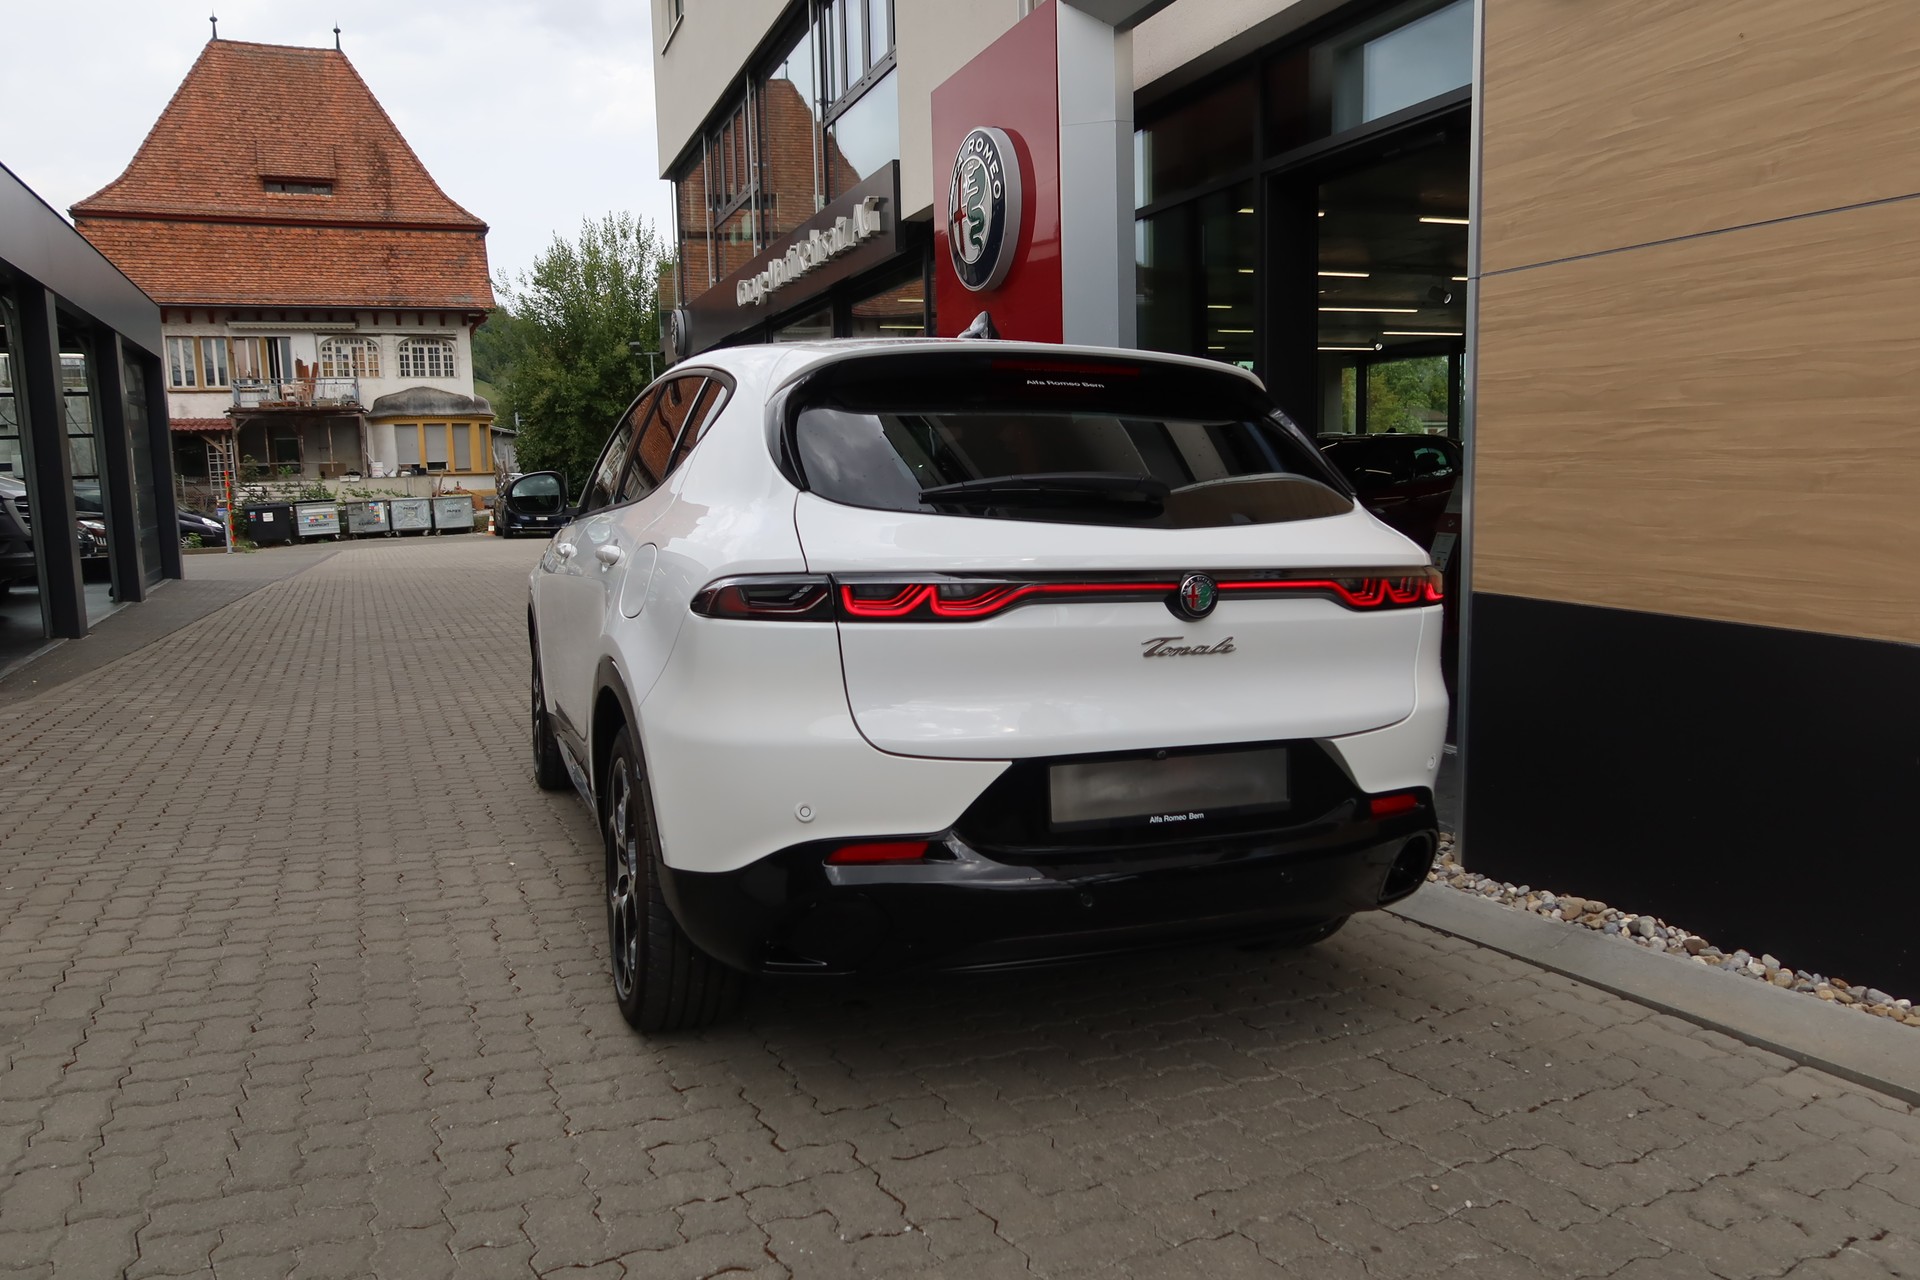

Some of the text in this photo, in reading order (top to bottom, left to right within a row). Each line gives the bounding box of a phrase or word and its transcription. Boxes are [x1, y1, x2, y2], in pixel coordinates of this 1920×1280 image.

[968, 137, 1002, 199] ROMEO
[852, 195, 881, 243] AG
[1141, 636, 1237, 658] Tonale
[1149, 812, 1205, 824] Alfa Romeo Bern
